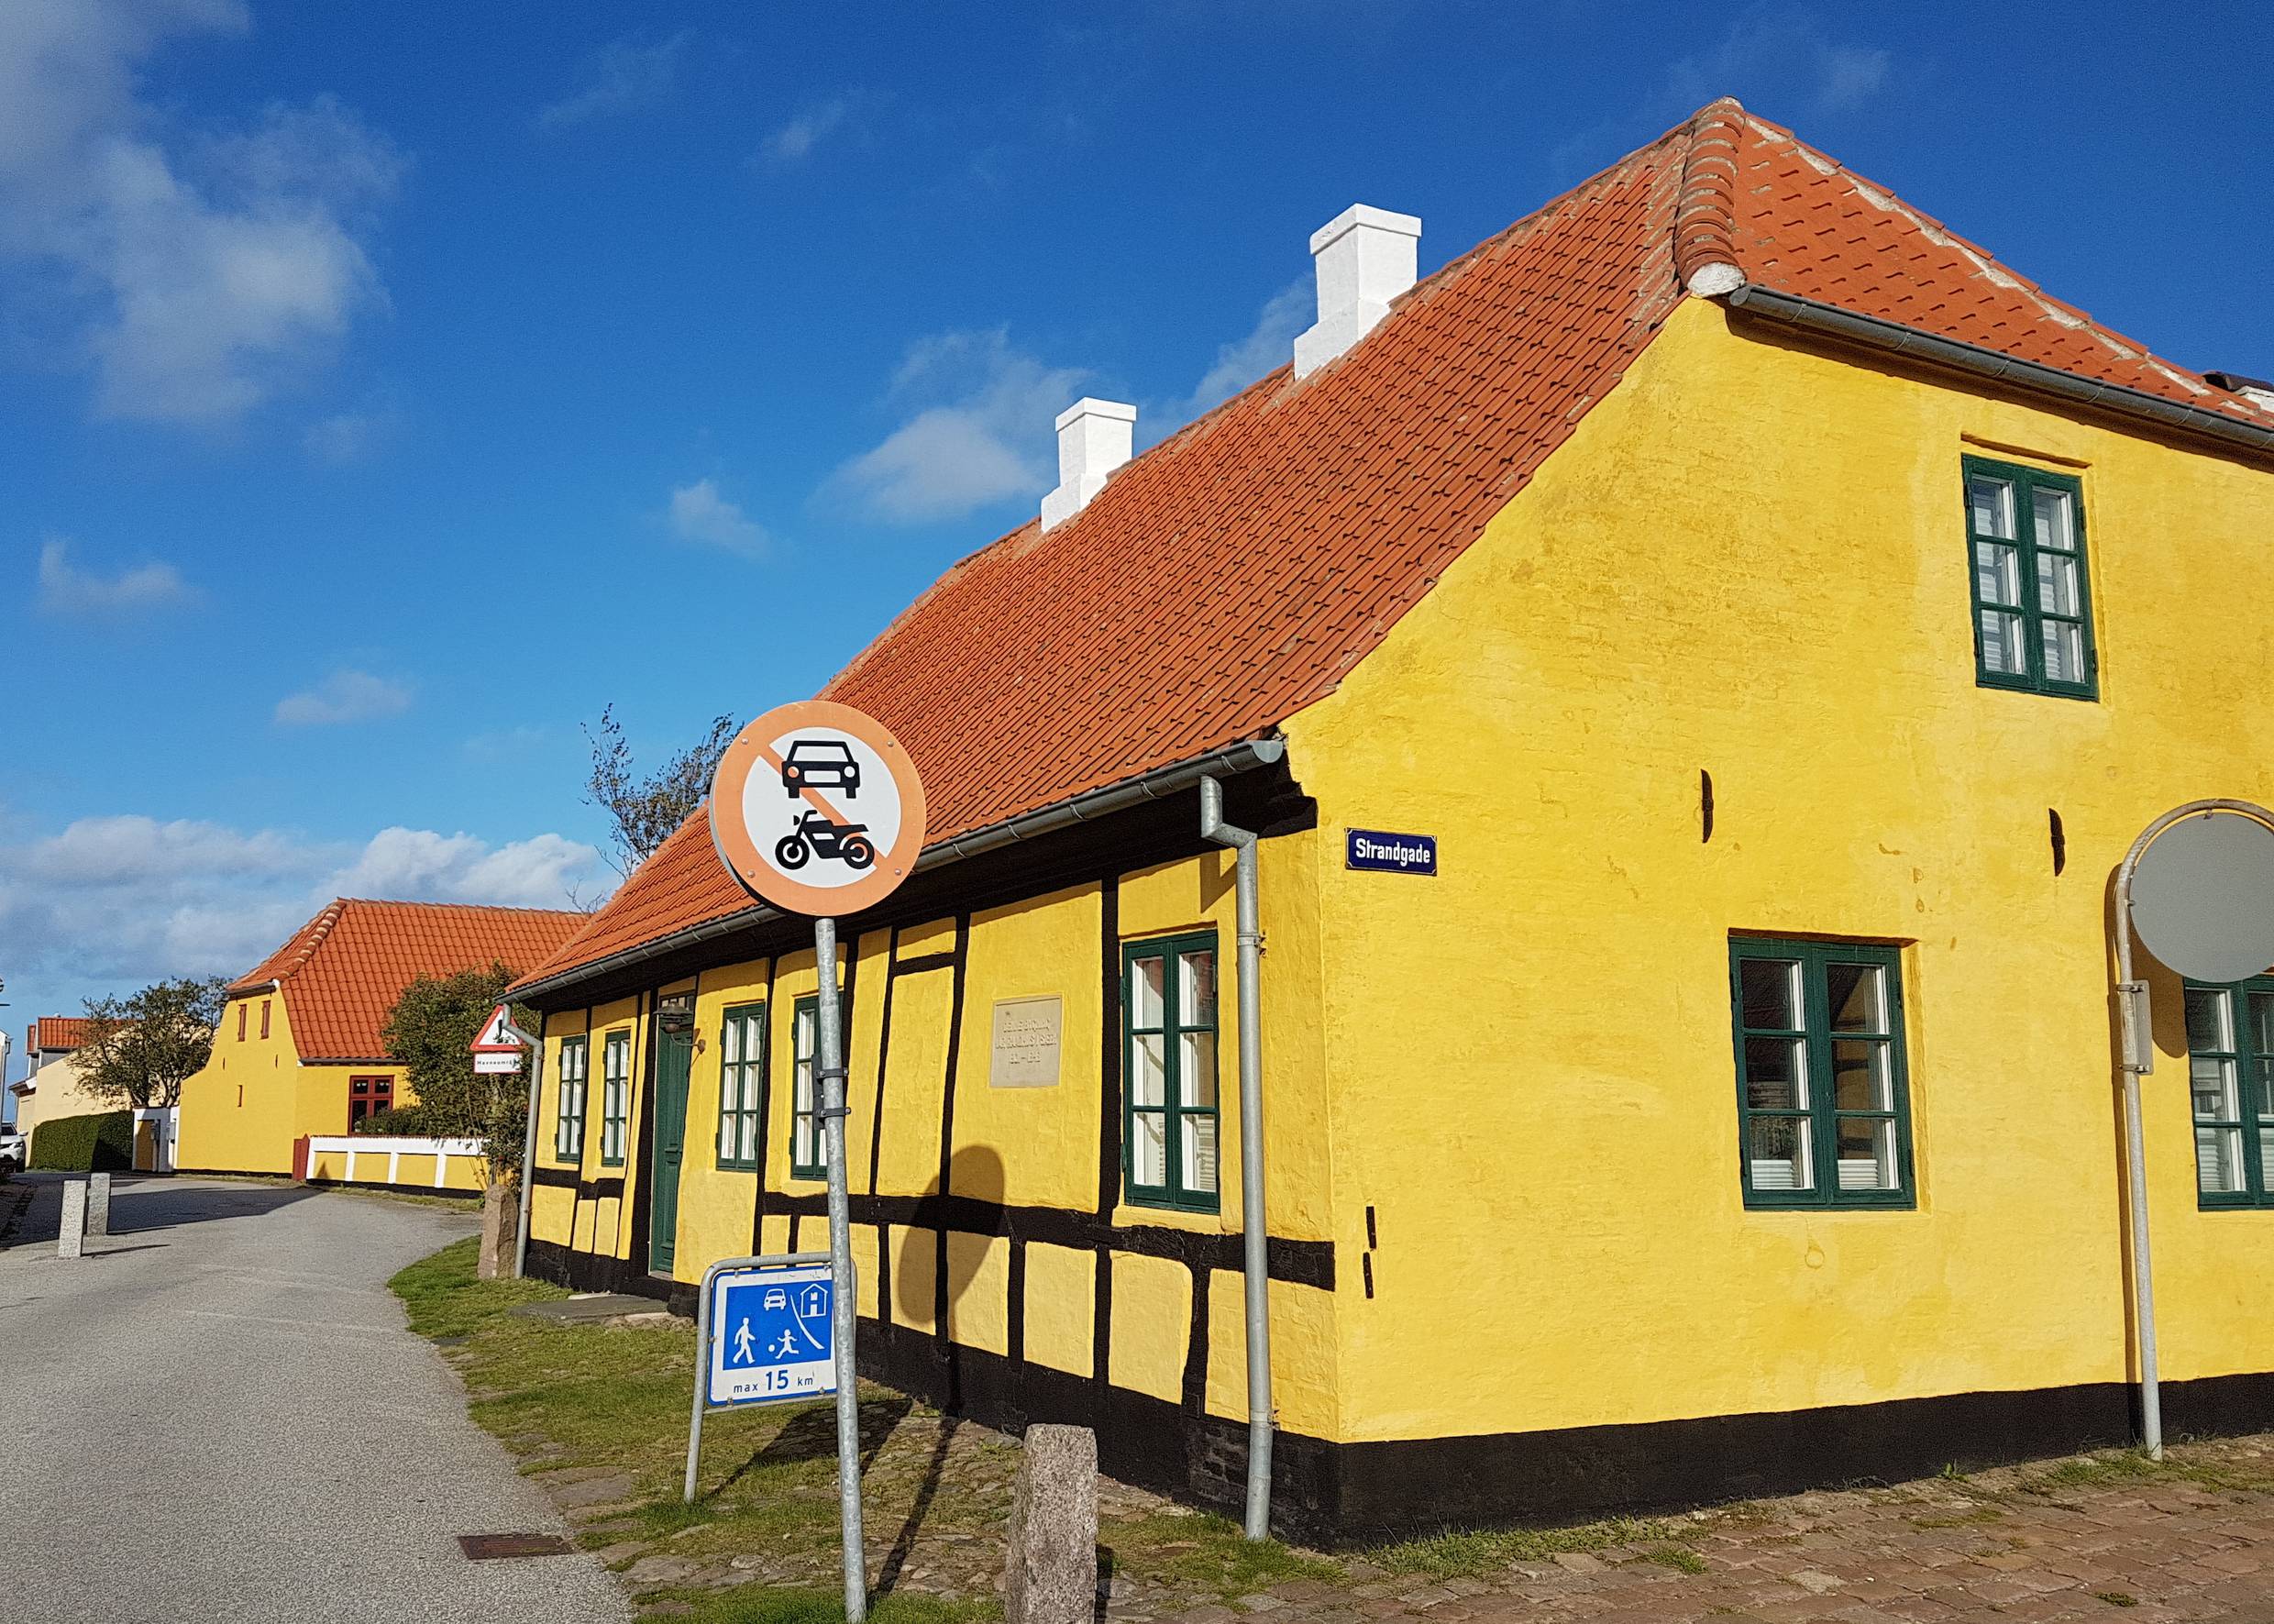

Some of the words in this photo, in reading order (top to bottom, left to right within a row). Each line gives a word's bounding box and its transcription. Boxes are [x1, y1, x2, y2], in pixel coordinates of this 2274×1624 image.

[1355, 837, 1430, 867] Strandgade
[734, 1383, 758, 1393] max
[766, 1369, 789, 1390] 15
[797, 1376, 813, 1386] km
